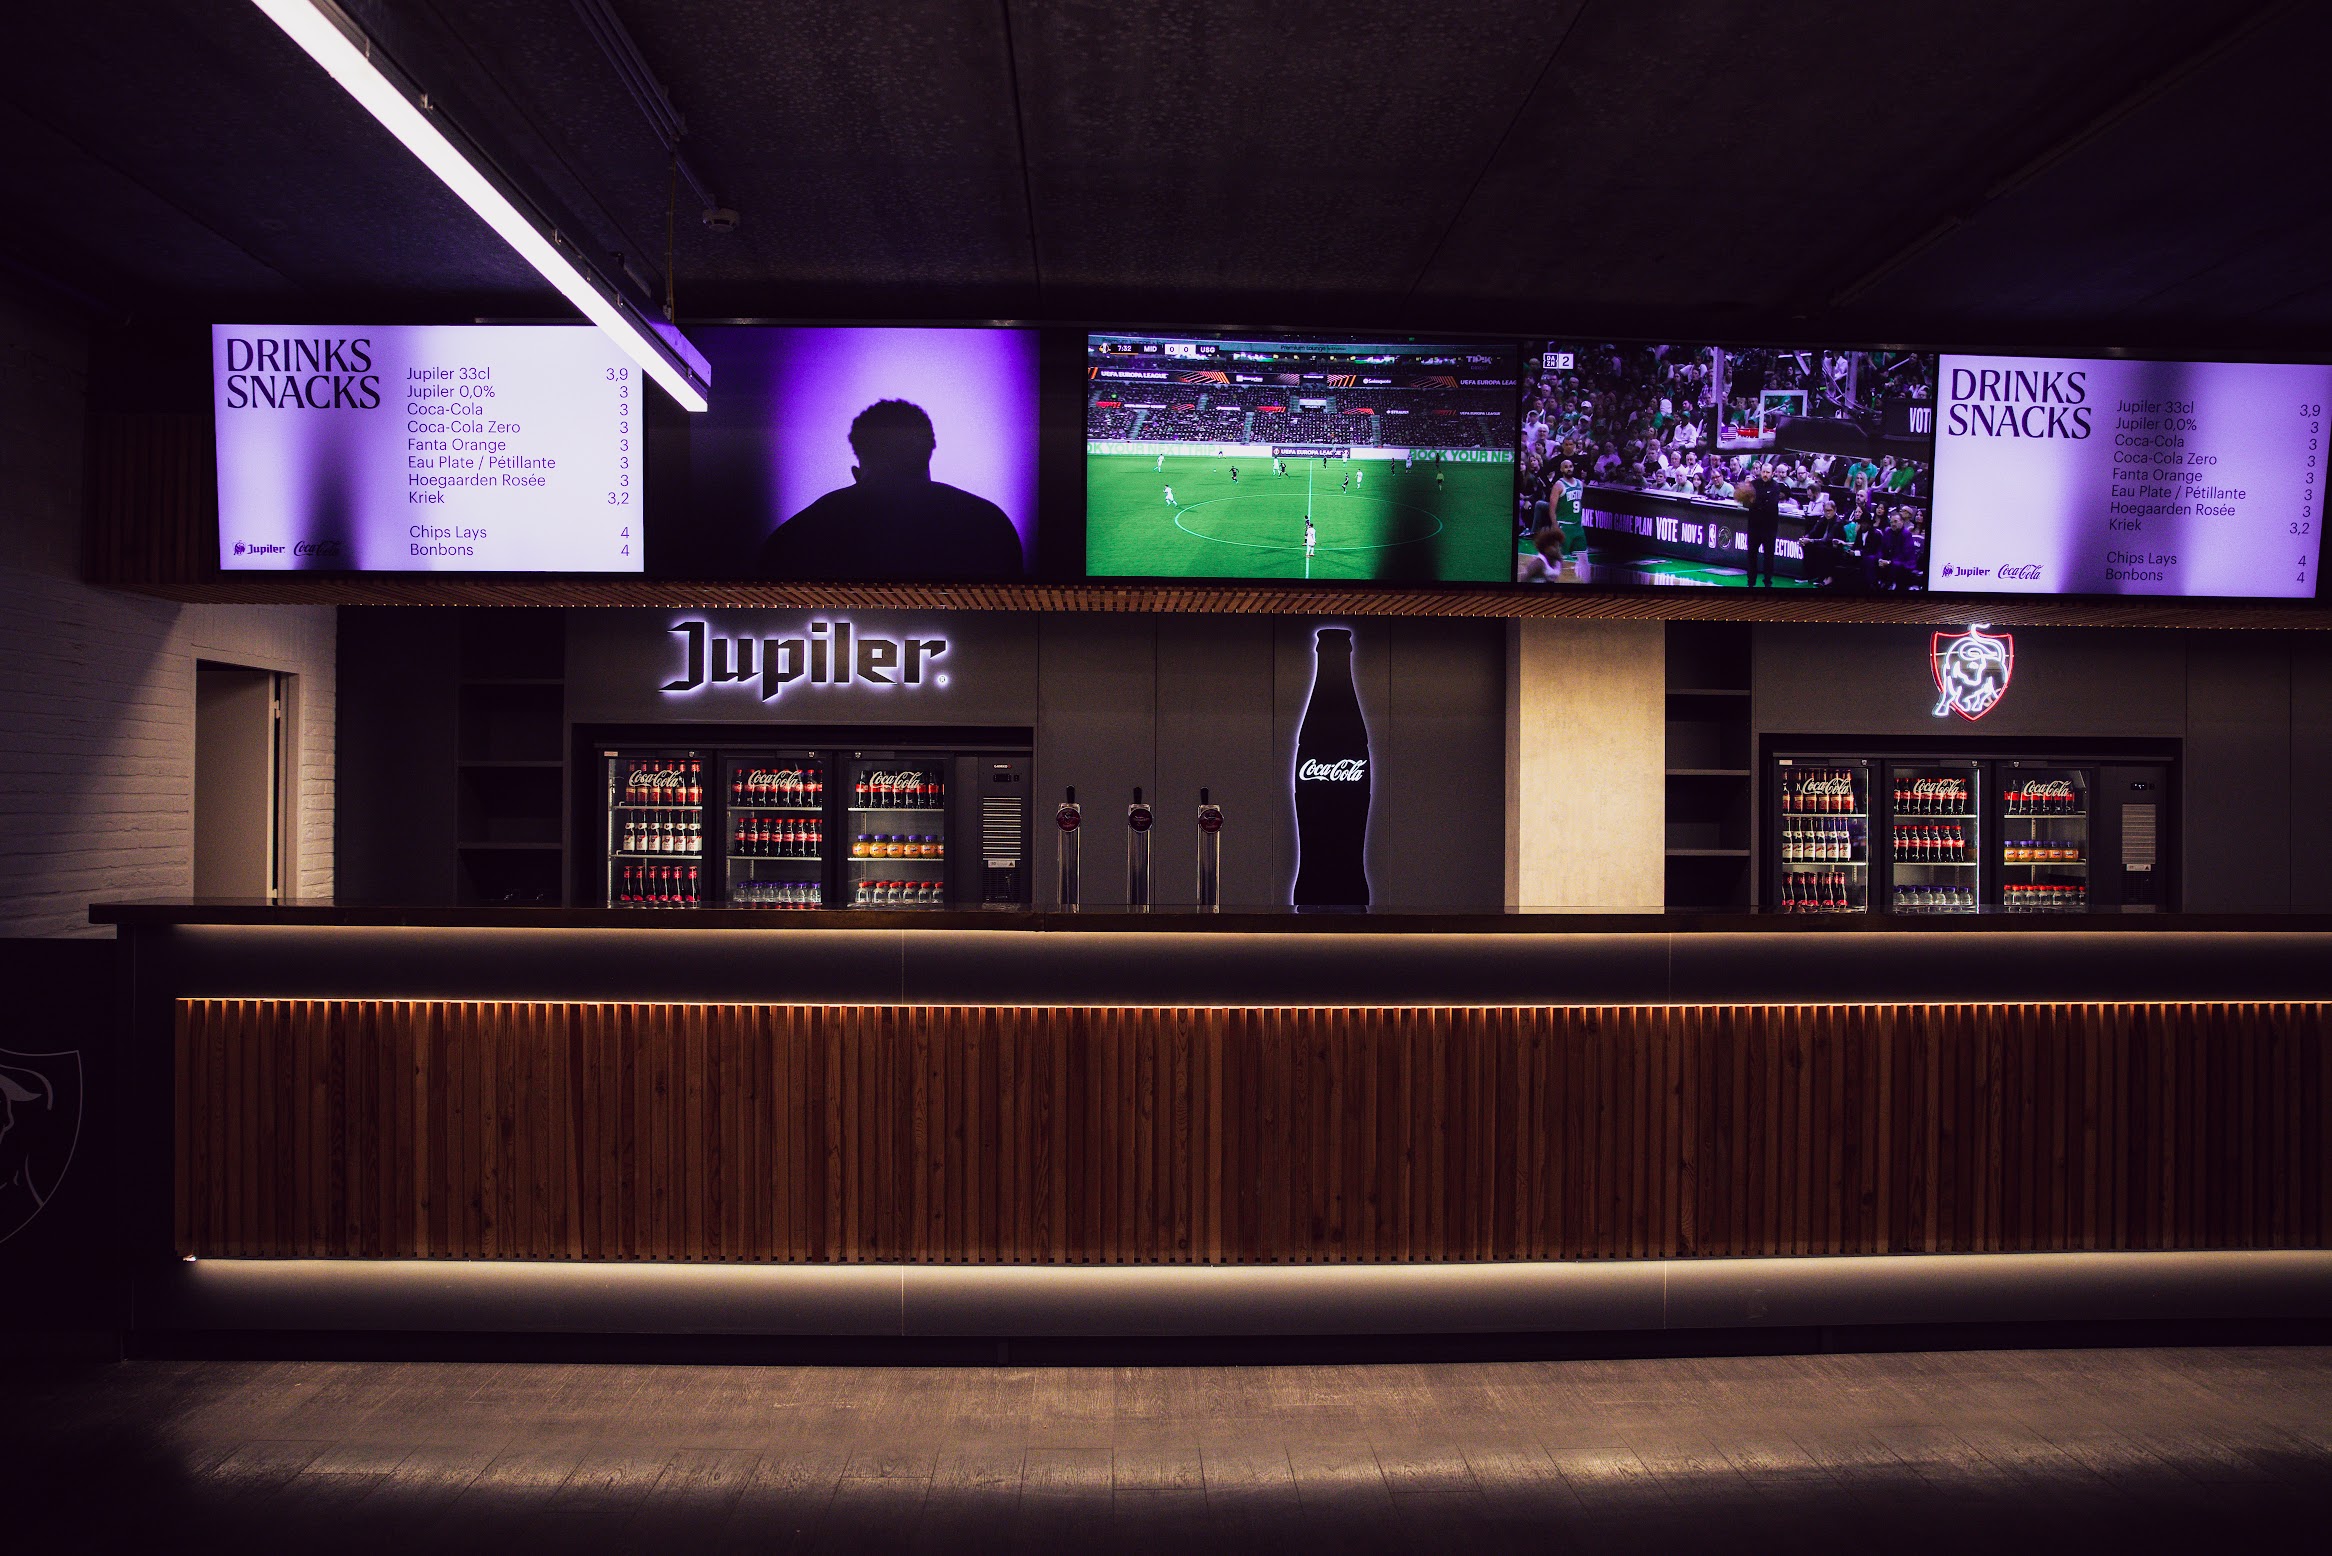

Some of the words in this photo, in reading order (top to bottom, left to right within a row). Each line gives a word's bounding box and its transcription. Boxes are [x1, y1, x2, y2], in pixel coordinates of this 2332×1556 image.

[227, 339, 371, 372] DRINKS
[1562, 356, 1570, 366] 2
[407, 367, 454, 382] Jupiler
[460, 367, 489, 379] 33cl
[607, 368, 627, 381] 3,9
[228, 375, 380, 409] SNACKS
[407, 385, 454, 400] Jupiler
[460, 386, 495, 398] 0,0%
[620, 386, 628, 398] 3
[1952, 369, 2085, 404] DRINKS
[408, 403, 482, 415] Coca-Cola
[620, 404, 628, 415] 3
[2117, 400, 2161, 414] Jupiler
[2165, 401, 2193, 413] 33cl
[2300, 405, 2320, 417] 3,9
[408, 421, 482, 432] Coca-Cola
[489, 421, 520, 433] Zero
[620, 422, 628, 433] 3
[1949, 404, 2091, 439] SNACKS
[2116, 417, 2158, 431] Jupiler
[2165, 418, 2197, 431] 0,0%
[2311, 422, 2318, 433] 3
[409, 439, 446, 450] Fanta
[453, 439, 505, 453] Orange
[621, 439, 628, 451] 3
[1106, 443, 1145, 453] YOUR
[1148, 444, 1187, 454] NEXT
[1188, 445, 1216, 455] TRIP
[2115, 434, 2184, 447] Coca-Cola
[2309, 439, 2317, 450] 3
[409, 456, 433, 468] Eau
[440, 456, 473, 468] Plate
[478, 455, 484, 470] /
[490, 456, 555, 468] Pétillante
[621, 457, 628, 468] 3
[1410, 449, 1448, 460] BOOK
[1451, 450, 1489, 462] YOUR
[2114, 451, 2183, 464] Coca-Cola
[2187, 453, 2217, 465] Zero
[2308, 456, 2315, 467] 3
[409, 473, 496, 488] Hoegaarden
[503, 474, 545, 486] Rosée
[621, 475, 628, 486] 3
[2113, 468, 2148, 480] Fanta
[2153, 469, 2202, 484] Orange
[2306, 472, 2313, 484] 3
[410, 491, 444, 503] Kriek
[608, 492, 628, 505] 3,2
[2112, 485, 2134, 497] Eau
[2140, 485, 2171, 498] Plate
[2175, 486, 2182, 500] /
[2186, 486, 2245, 499] Pétillante
[2304, 489, 2312, 500] 3
[1573, 501, 1580, 513] 9
[2111, 502, 2191, 516] Hoegaarden
[2196, 504, 2235, 516] Rosée
[2303, 506, 2310, 517] 3
[410, 525, 450, 541] Chips
[456, 526, 486, 540] Lays
[621, 527, 629, 538] 4
[1595, 510, 1613, 530] YOUR
[1614, 513, 1634, 533] GAME
[1635, 516, 1653, 537] PLAN
[1656, 516, 1678, 543] VOTE
[1682, 522, 1698, 544] NOV
[1698, 525, 1702, 544] 5
[2110, 519, 2142, 530] Kriek
[2290, 522, 2309, 535] 3,2
[247, 544, 286, 556] Jupiler
[411, 543, 473, 555] Bonbons
[621, 545, 629, 556] 4
[2107, 551, 2144, 566] Chips
[2149, 553, 2176, 566] Lays
[2298, 556, 2306, 566] 4
[1955, 566, 1990, 577] Jupiler
[1998, 564, 2044, 580] Coca-Cola
[2106, 568, 2163, 581] Bonbons
[2297, 572, 2304, 583] 4
[658, 621, 947, 703] Jupiler
[1299, 759, 1367, 781] Coca-Cola
[629, 770, 684, 788] Coca-Cola
[748, 770, 801, 788] Coca-Cola
[869, 771, 923, 789] Coca-Cola
[1802, 778, 1851, 795] Coca-Cola
[1913, 779, 1962, 795] Coca-Cola
[2024, 780, 2072, 797] Coca-Cola
